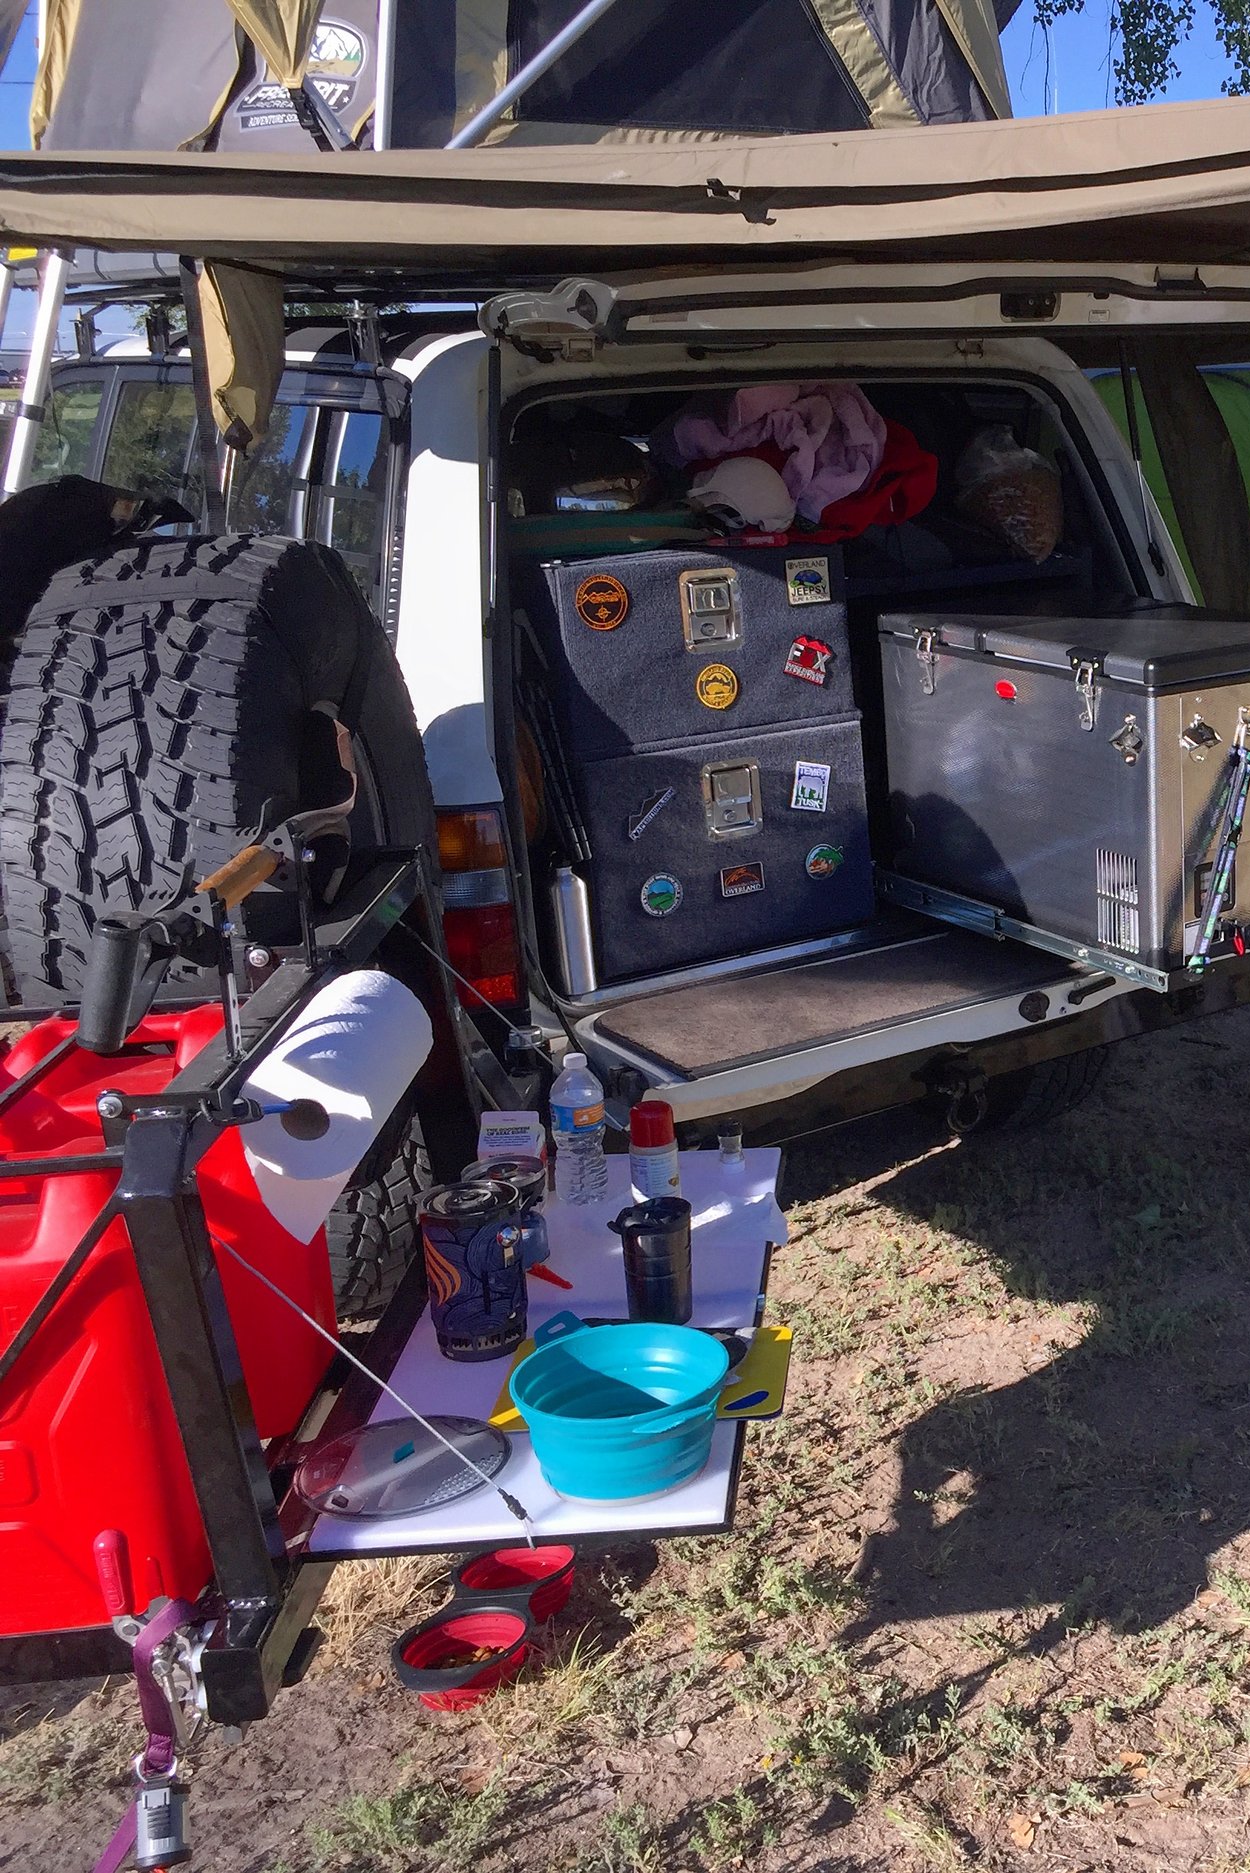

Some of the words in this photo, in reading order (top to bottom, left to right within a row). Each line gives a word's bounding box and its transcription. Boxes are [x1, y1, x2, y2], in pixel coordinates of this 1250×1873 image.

[248, 114, 286, 127] ADVENTURE
[792, 585, 828, 597] JEEPSY
[725, 883, 762, 895] OVERLAND
